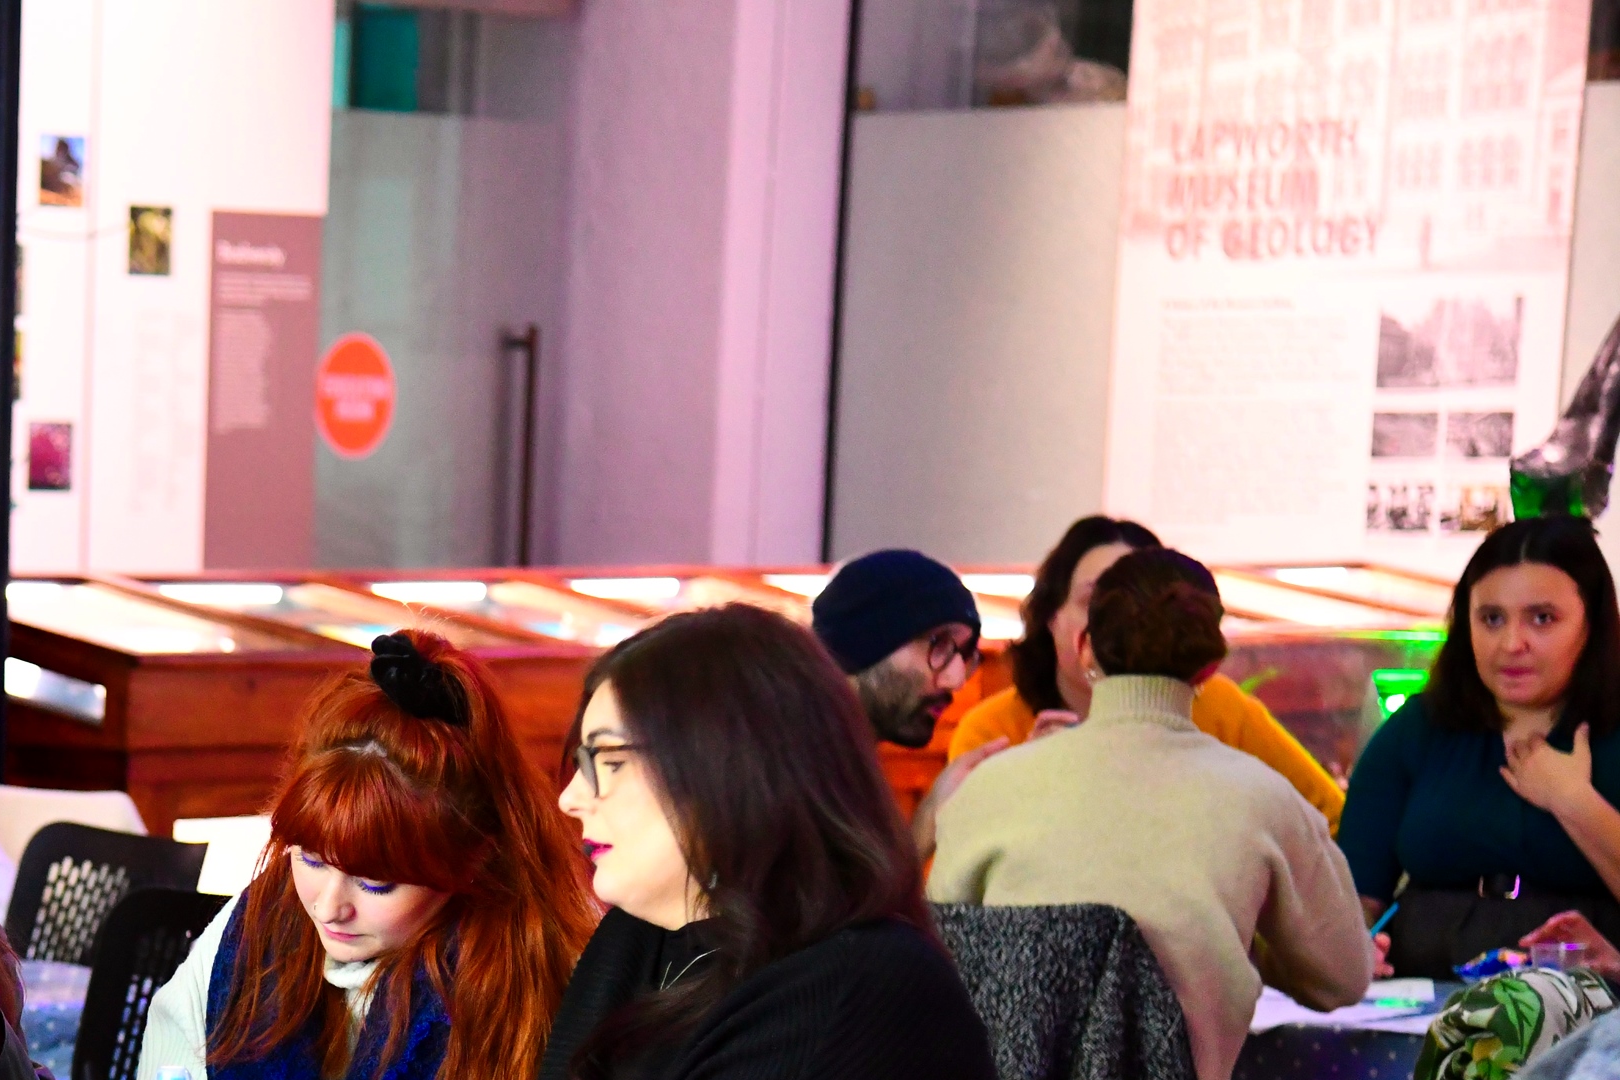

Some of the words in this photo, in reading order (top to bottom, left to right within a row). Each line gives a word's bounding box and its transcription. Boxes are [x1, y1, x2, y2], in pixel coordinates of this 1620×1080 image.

[1170, 118, 1359, 163] LAPWORTH
[1166, 168, 1319, 210] MUSEUM
[1165, 220, 1208, 261] OF
[1221, 212, 1379, 260] GEOLOGY
